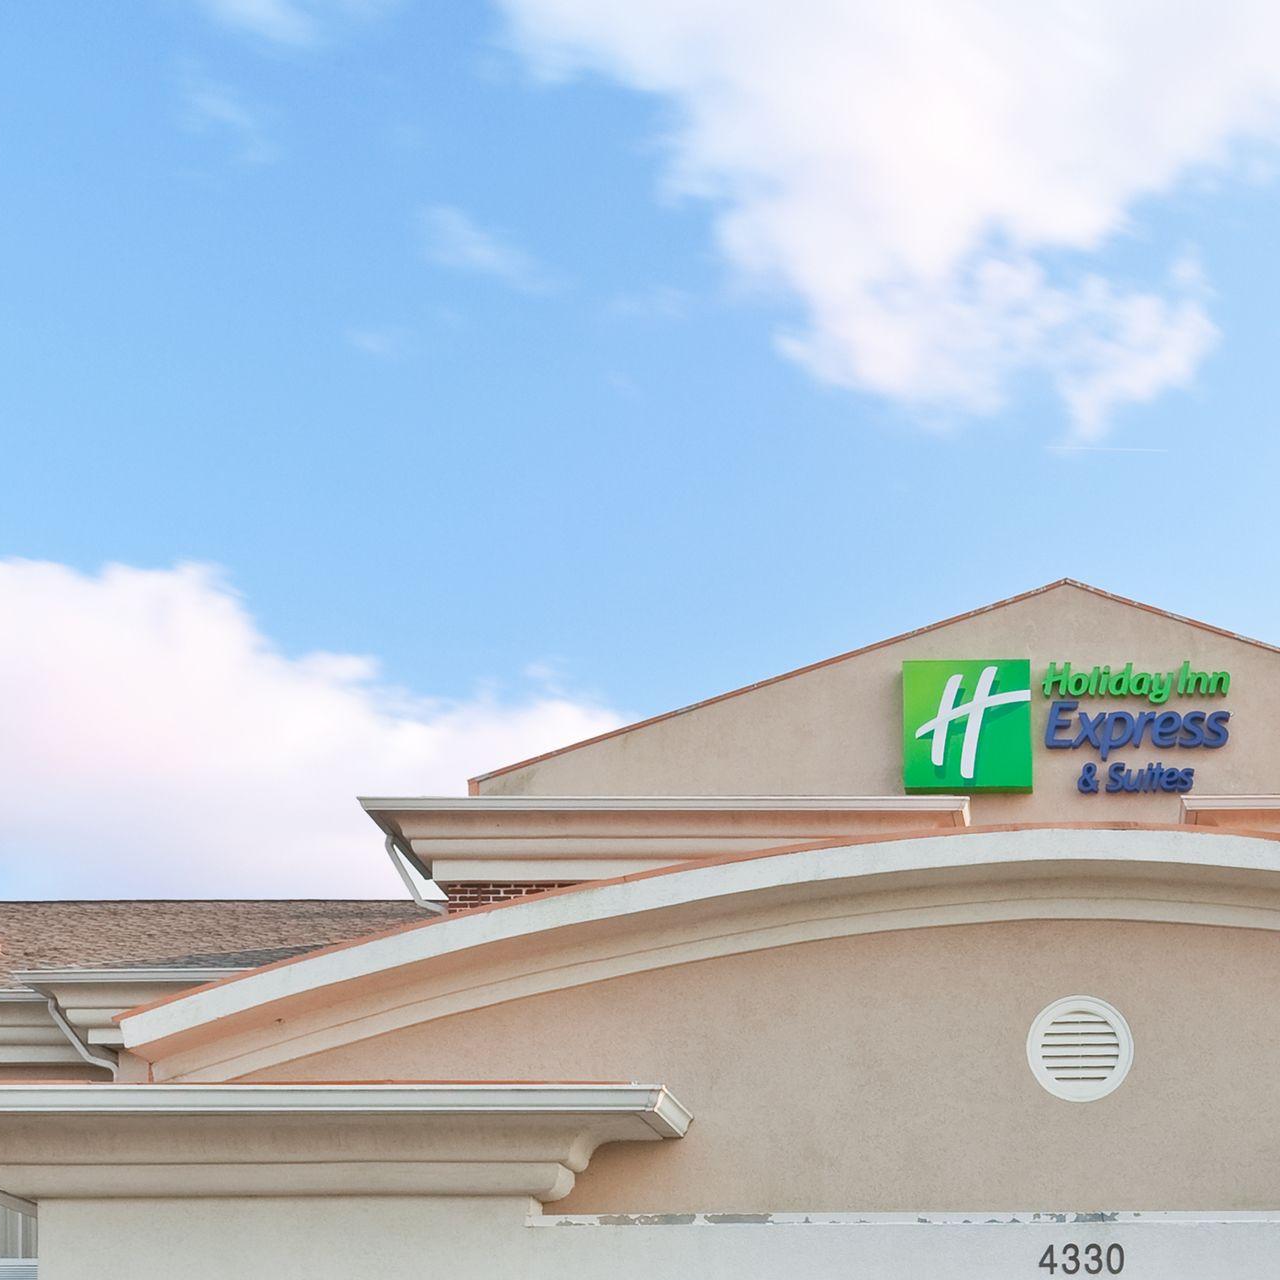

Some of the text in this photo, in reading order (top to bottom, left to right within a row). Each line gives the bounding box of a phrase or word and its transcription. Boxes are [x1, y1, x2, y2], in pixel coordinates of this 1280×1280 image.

[1042, 660, 1231, 704] Holiday Inn
[915, 666, 1032, 779] H
[1044, 700, 1231, 761] Express
[1077, 761, 1195, 794] & Suites
[1038, 1243, 1125, 1275] 4330
